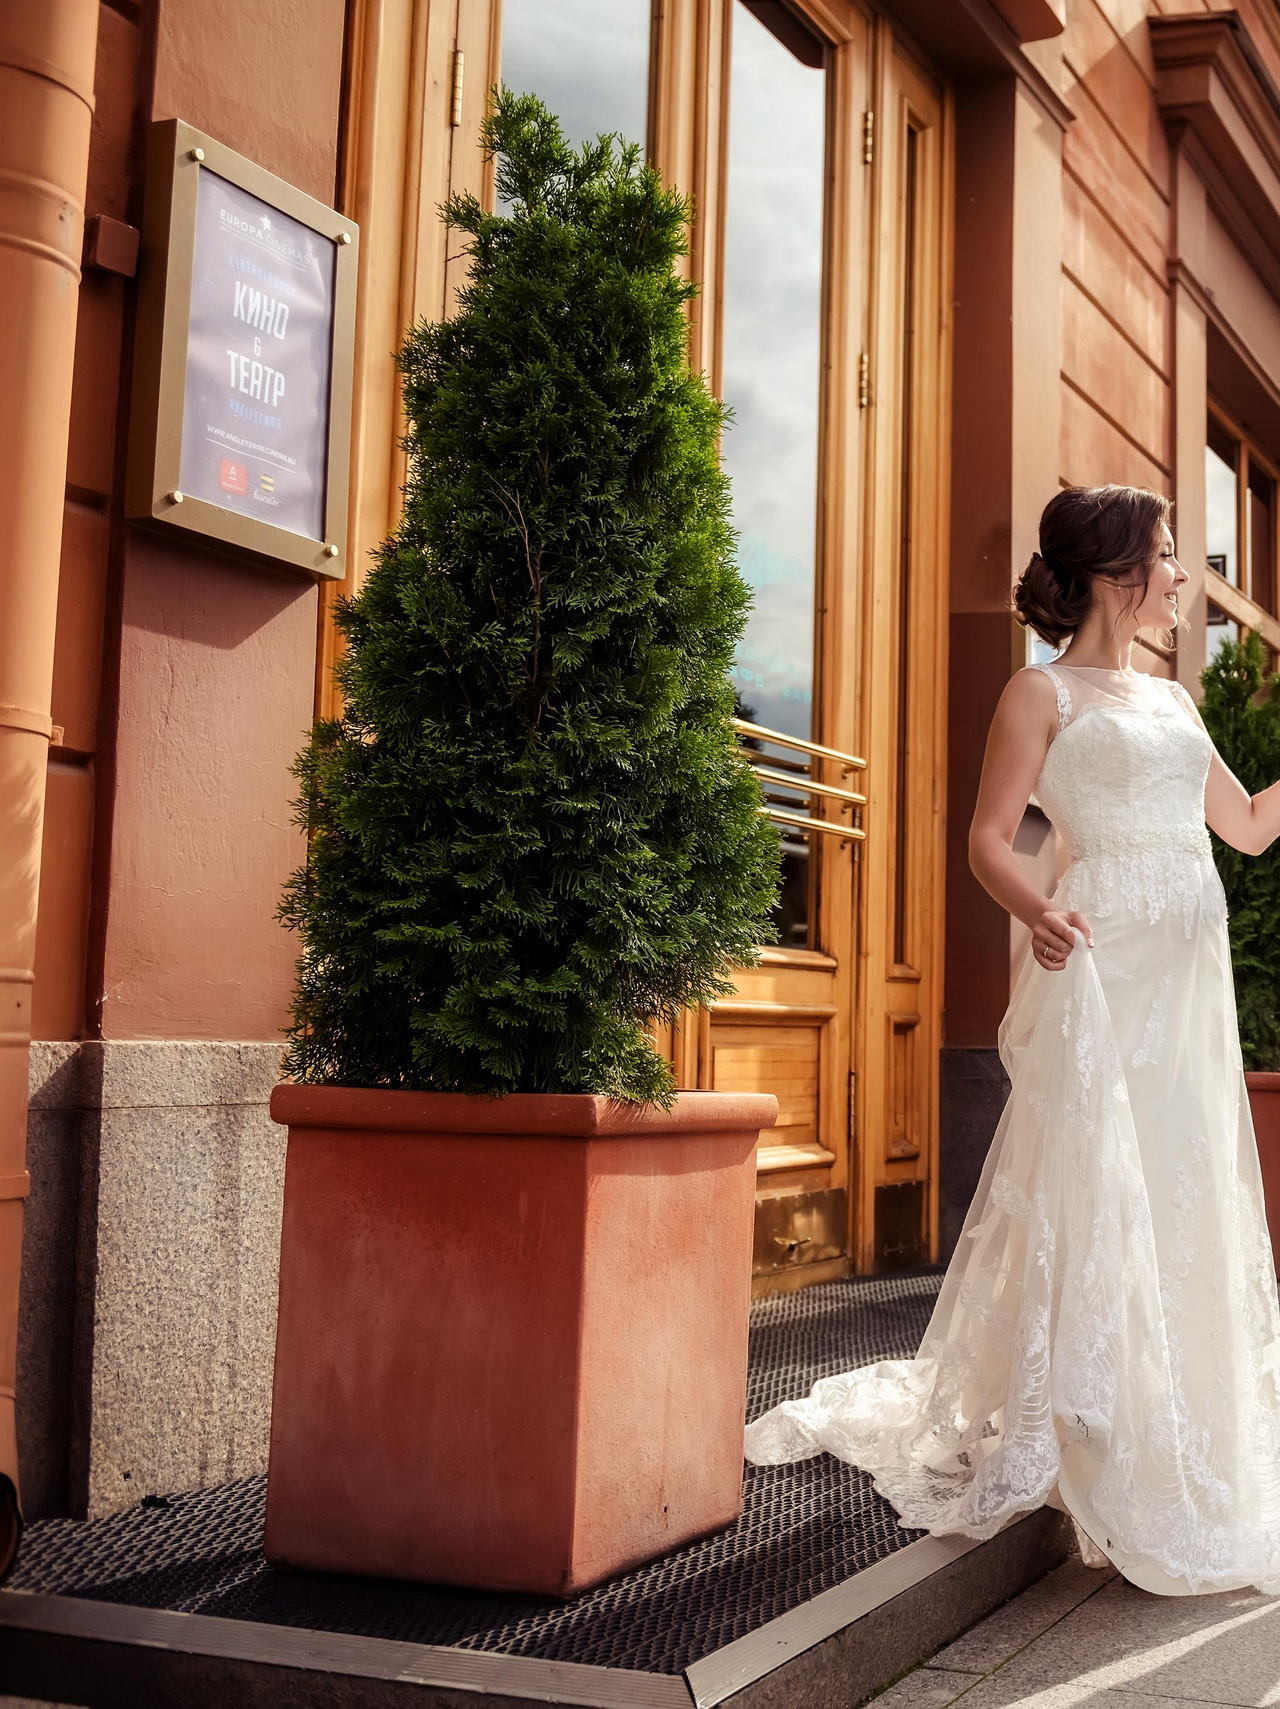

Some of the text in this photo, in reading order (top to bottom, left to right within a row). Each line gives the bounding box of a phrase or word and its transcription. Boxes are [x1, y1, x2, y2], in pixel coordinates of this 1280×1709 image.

[220, 209, 263, 240] EUROPA
[265, 234, 311, 265] CINEMAS
[233, 281, 290, 340] КИНО
[227, 350, 286, 407] ТЕАТР
